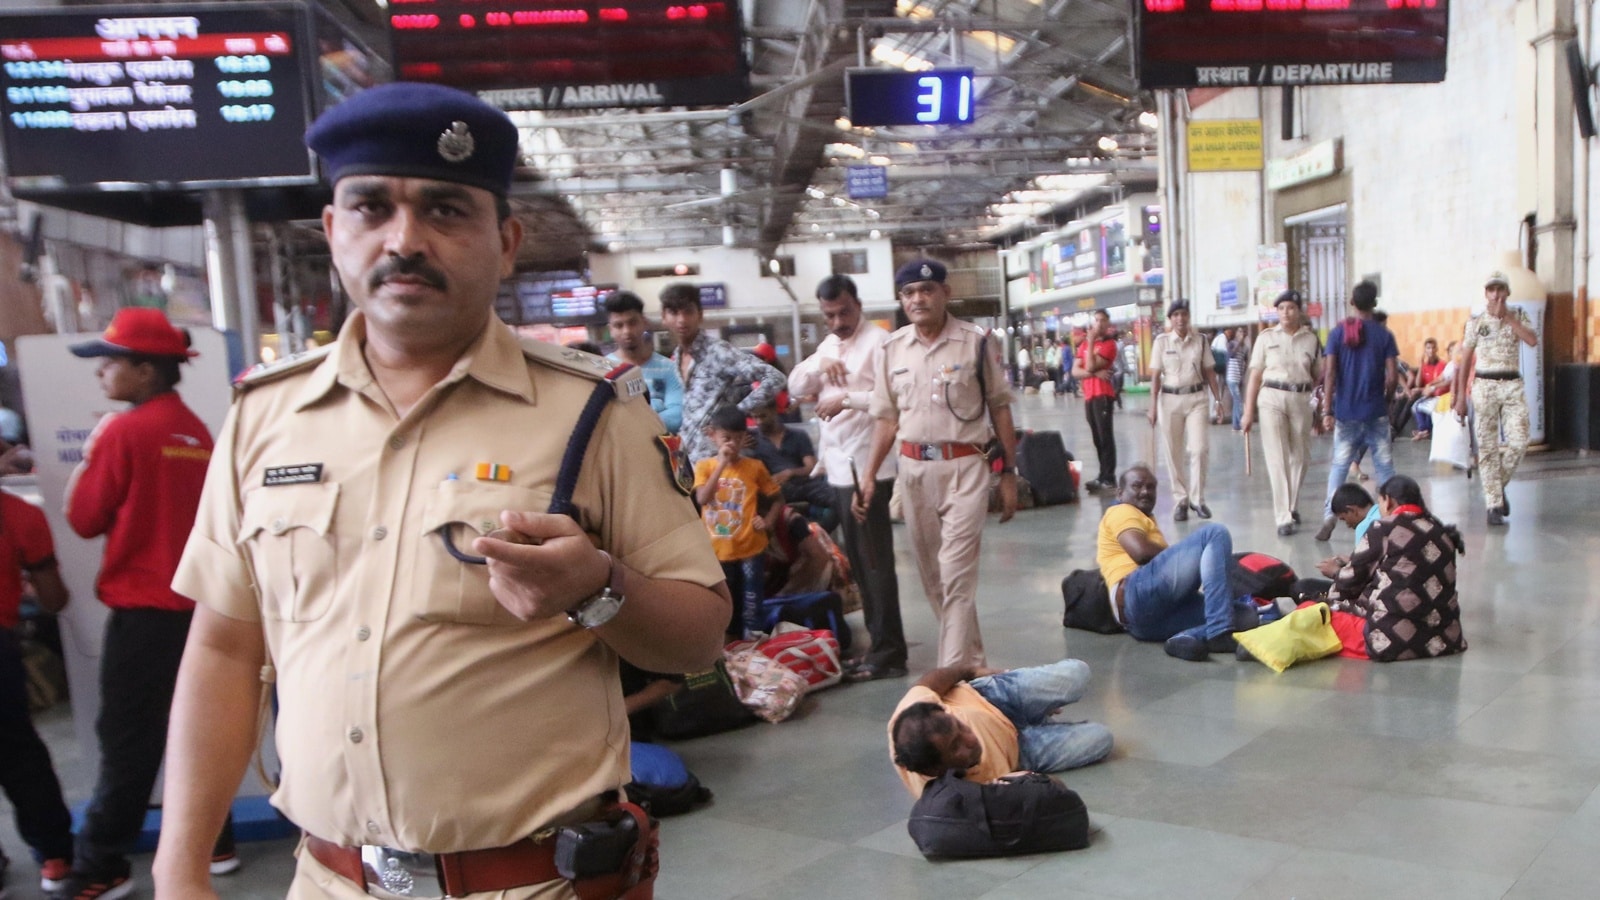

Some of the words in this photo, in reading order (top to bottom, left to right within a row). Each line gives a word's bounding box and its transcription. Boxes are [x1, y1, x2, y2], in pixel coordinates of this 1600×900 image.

[1196, 65, 1249, 83] प्रस्थान
[1273, 63, 1392, 81] DEPARTURE
[563, 84, 662, 105] ARRIVAL
[917, 76, 970, 122] 31
